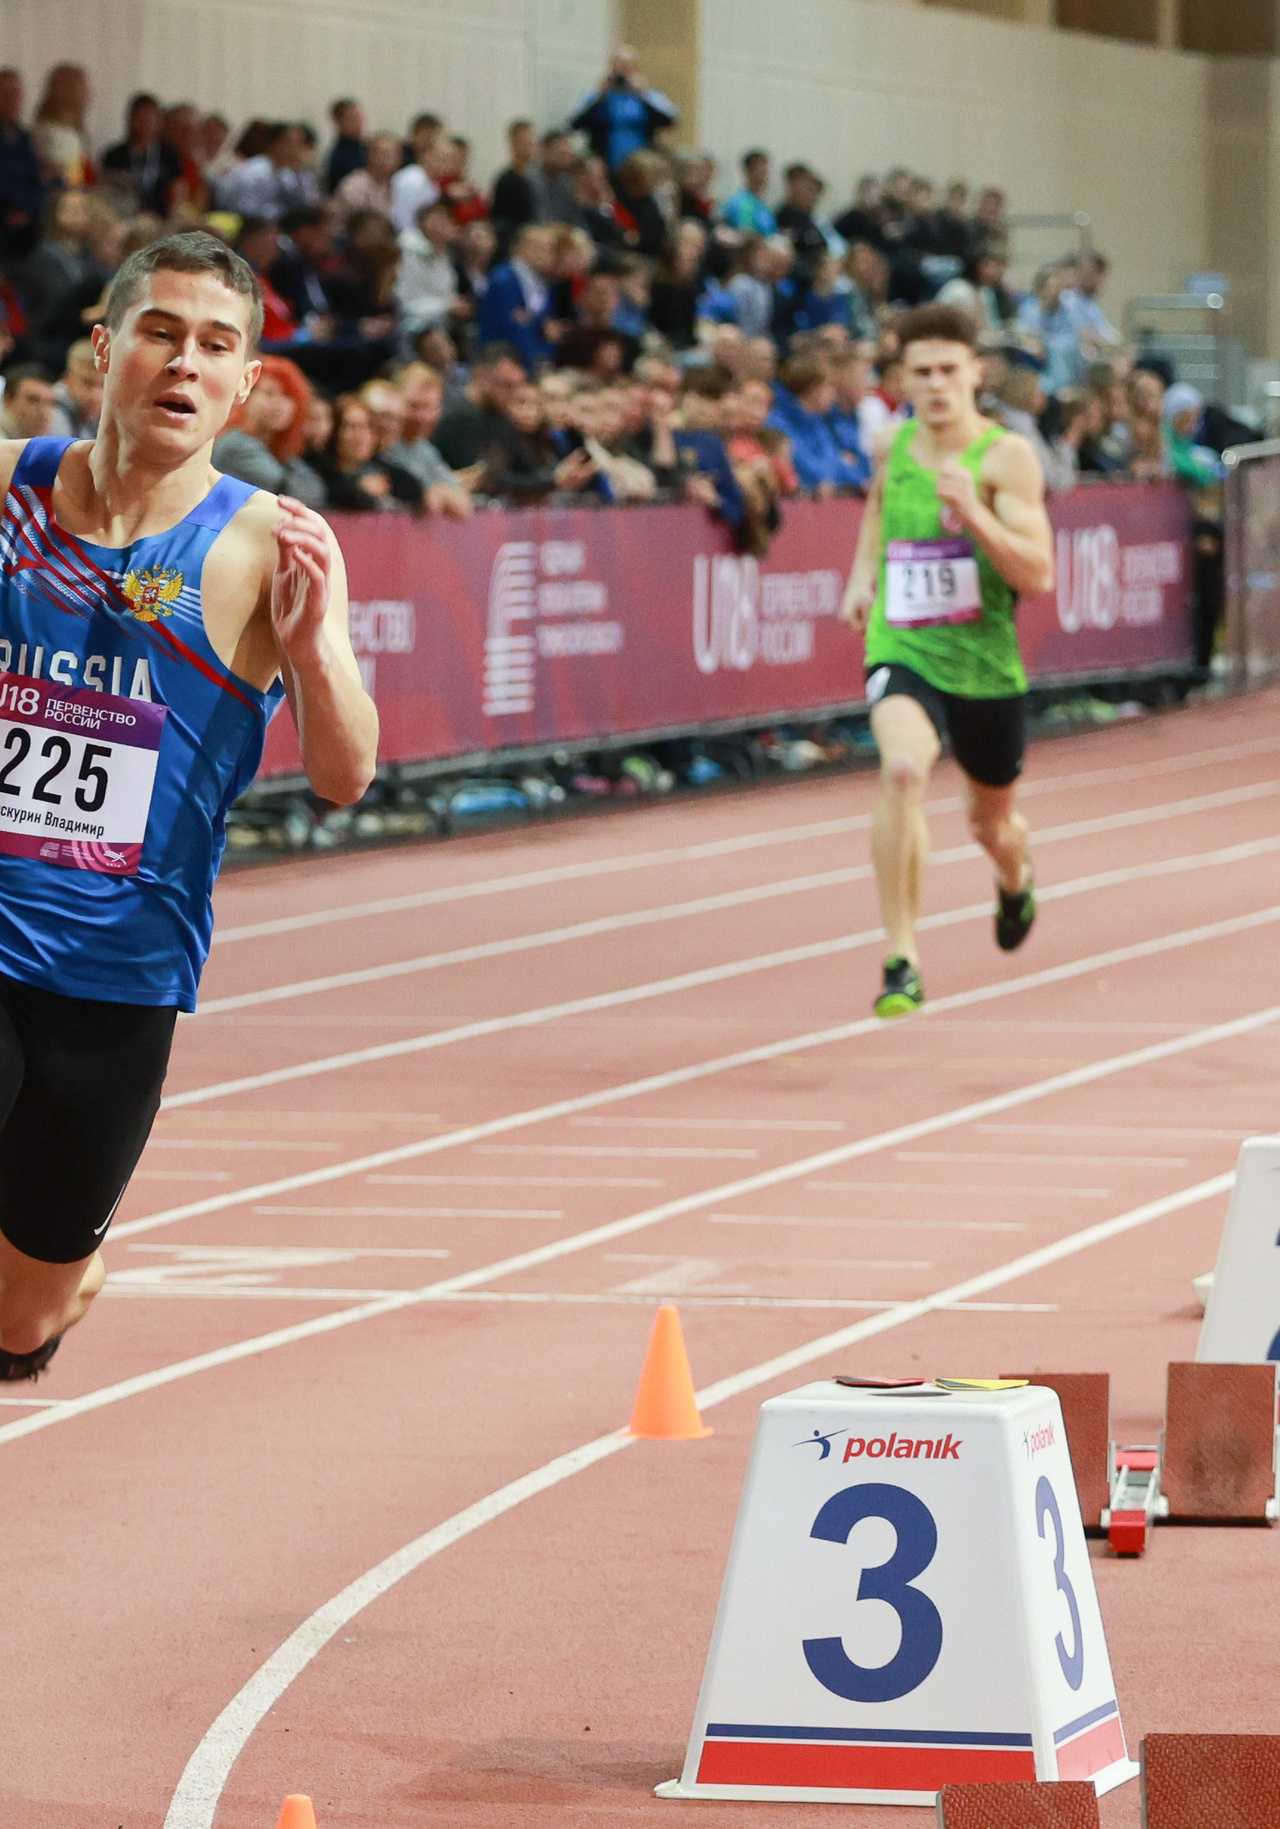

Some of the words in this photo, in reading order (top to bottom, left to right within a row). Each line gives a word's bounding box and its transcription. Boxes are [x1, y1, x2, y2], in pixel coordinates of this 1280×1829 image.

[903, 567, 957, 597] 219
[44, 710, 100, 730] РОССИИ
[46, 699, 136, 726] ПЕРВЕНСТВО
[44, 812, 105, 839] Владимир
[842, 1432, 964, 1463] polanik
[802, 1482, 943, 1703] 3
[1035, 1475, 1084, 1691] 3
